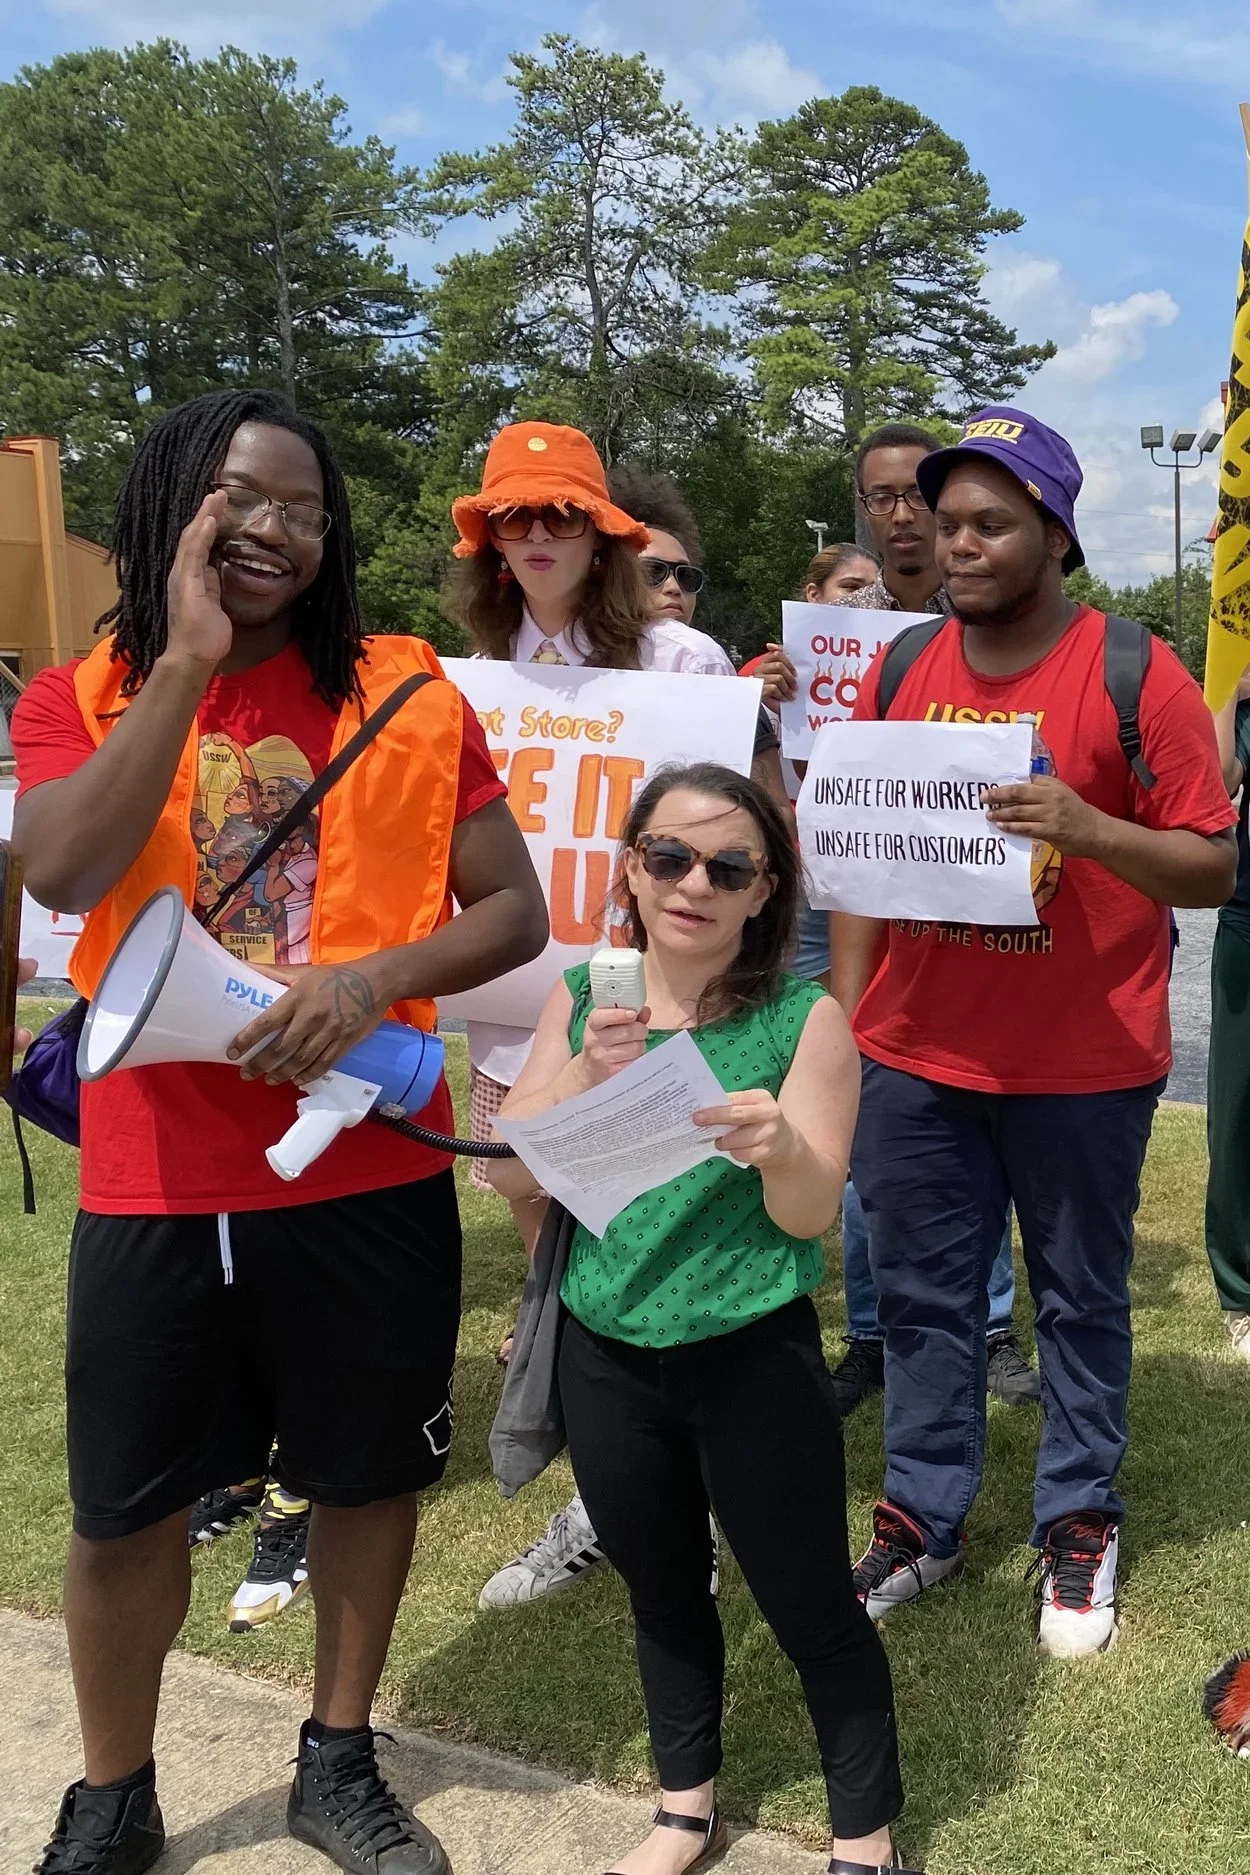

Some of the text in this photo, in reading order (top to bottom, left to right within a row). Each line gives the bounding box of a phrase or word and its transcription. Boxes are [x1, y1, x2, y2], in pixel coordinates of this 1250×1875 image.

[811, 635, 861, 657] OUR
[518, 706, 624, 743] Store?
[202, 751, 230, 763] USSW
[814, 776, 871, 806] UNSAFE
[876, 779, 906, 808] FOR
[816, 830, 1006, 866] UNSAFE FOR CUSTOMERS
[229, 935, 267, 944] SERVICE
[911, 921, 930, 938] UP
[936, 927, 973, 947] THE
[984, 928, 1053, 954] SOUTH
